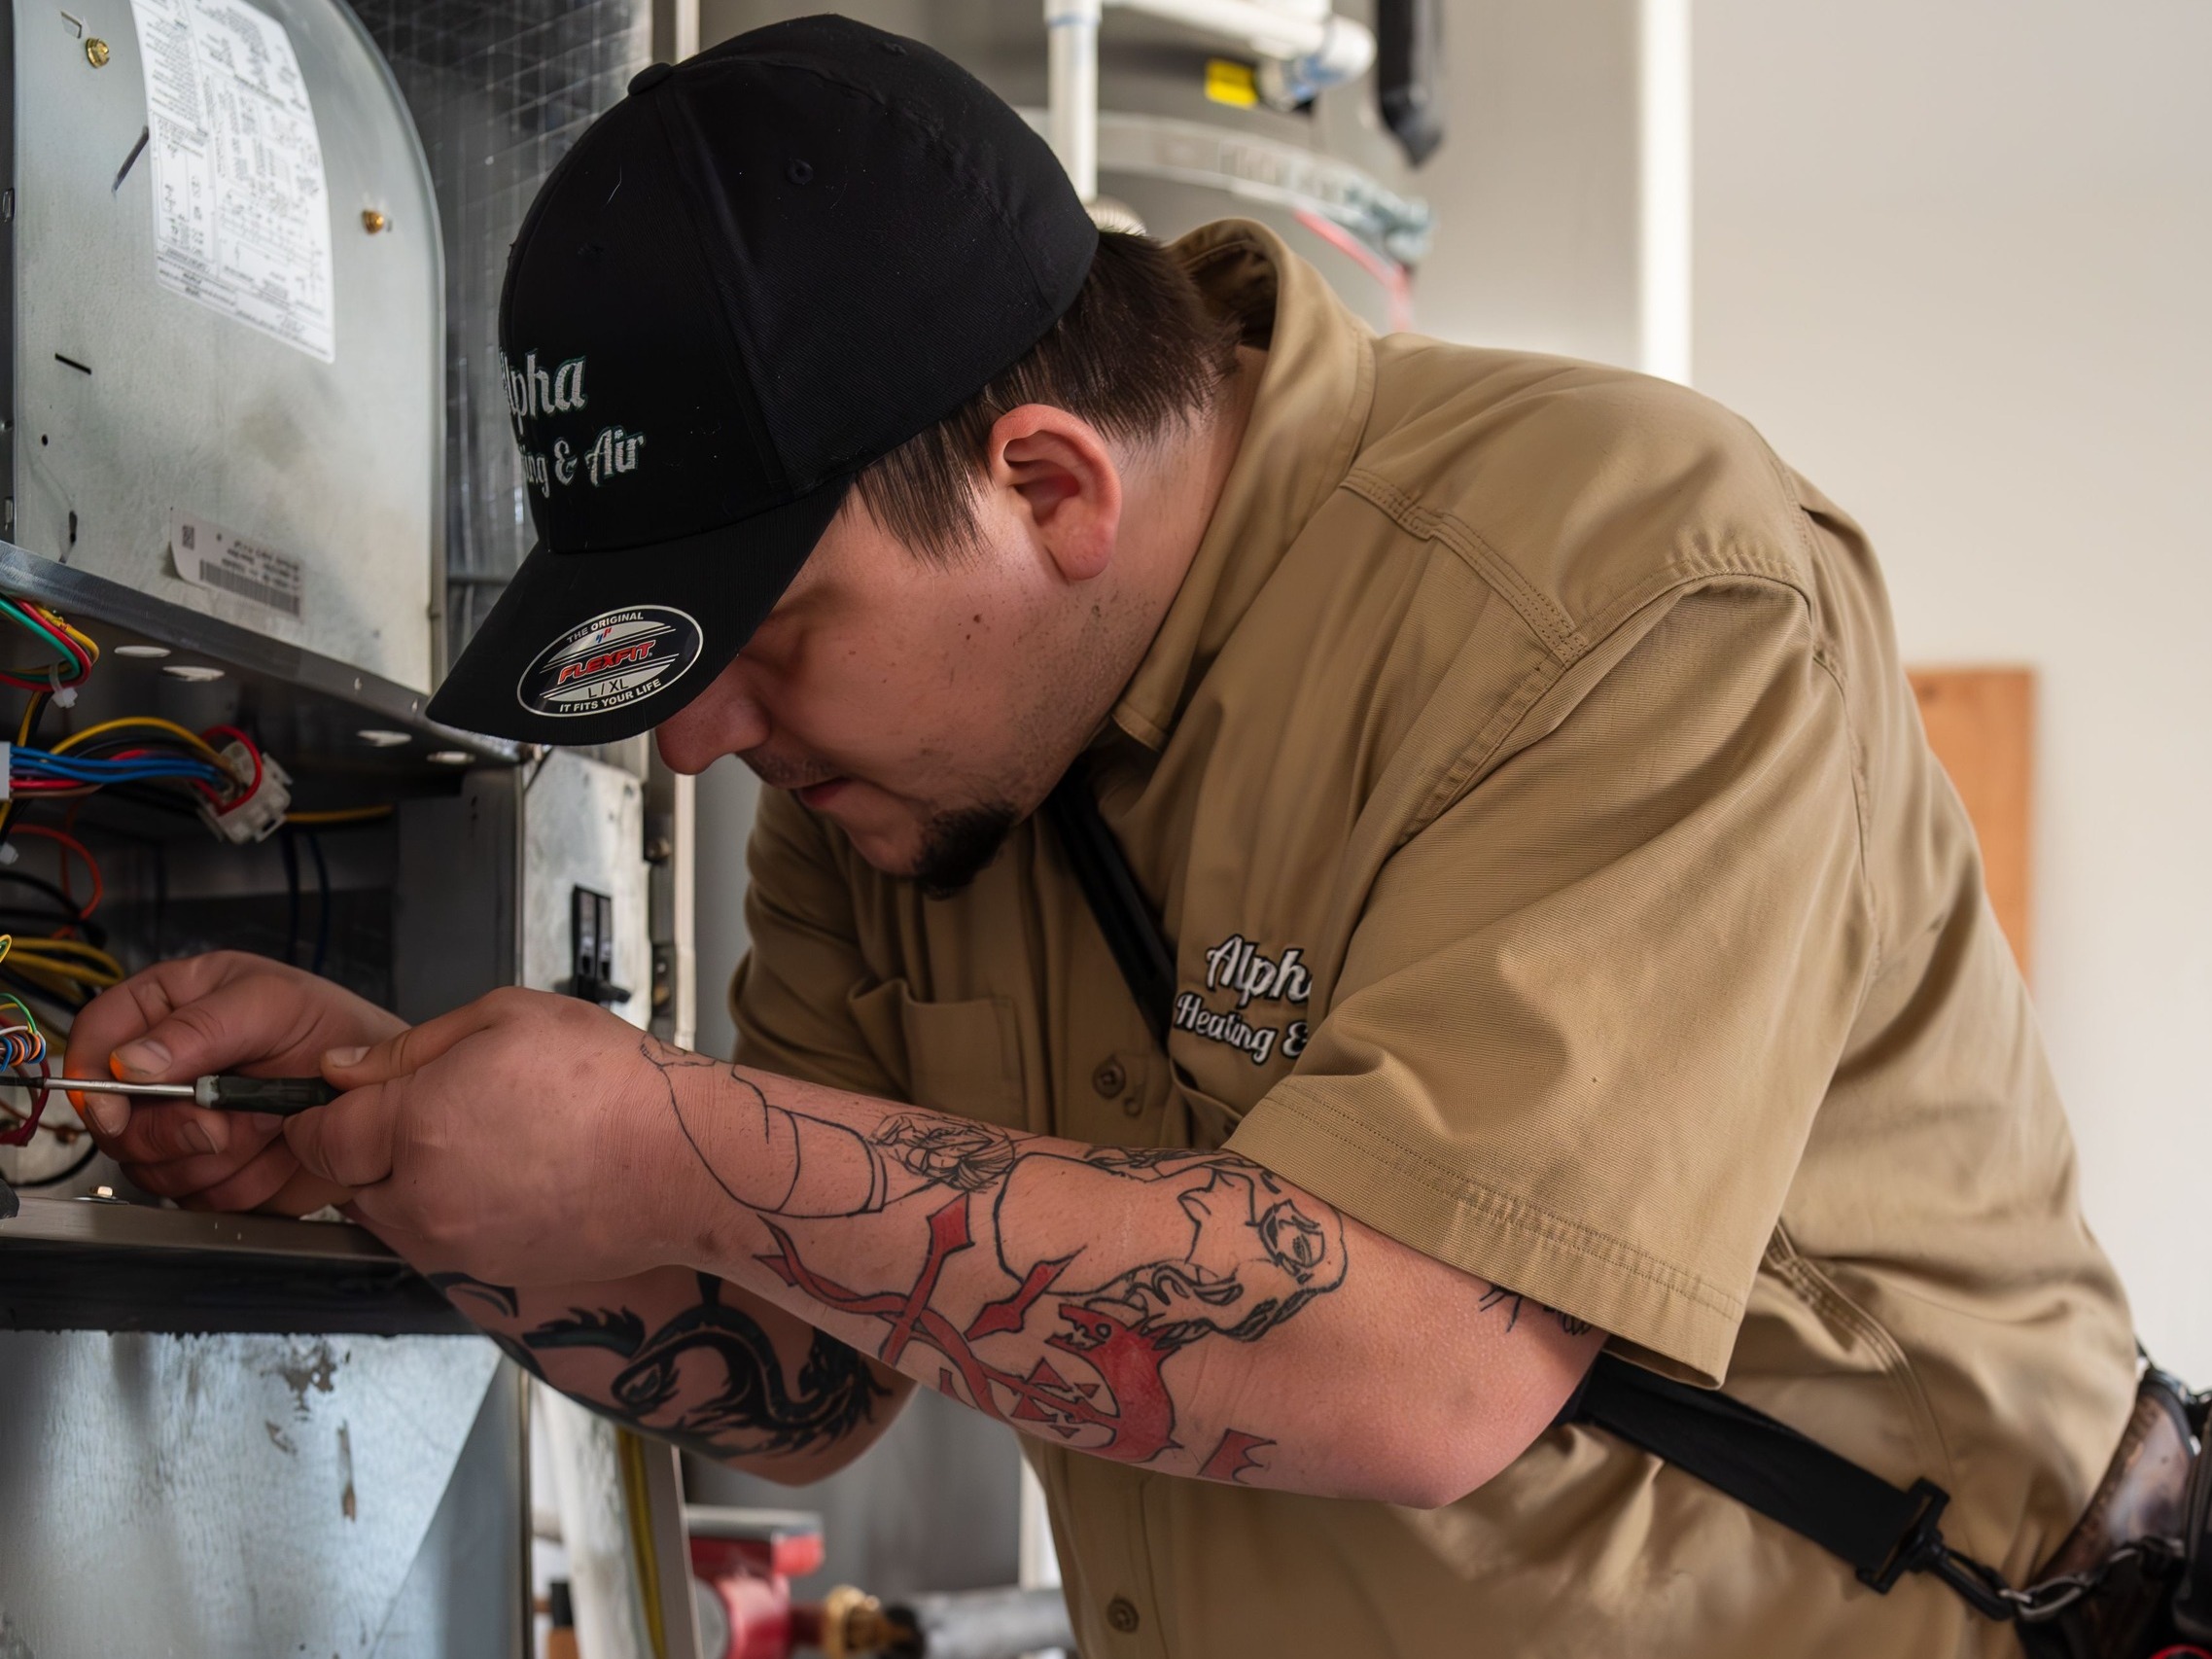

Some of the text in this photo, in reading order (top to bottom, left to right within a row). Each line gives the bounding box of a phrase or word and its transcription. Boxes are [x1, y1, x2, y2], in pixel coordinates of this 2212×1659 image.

[518, 428, 645, 499] ing & Air
[567, 612, 644, 643] THE ORIGINAL
[557, 639, 656, 685] FLEXFIT
[559, 679, 661, 713] IT FITS YOUR LIFE
[1206, 935, 1313, 1006] Alph
[1176, 994, 1309, 1064] Heating &
